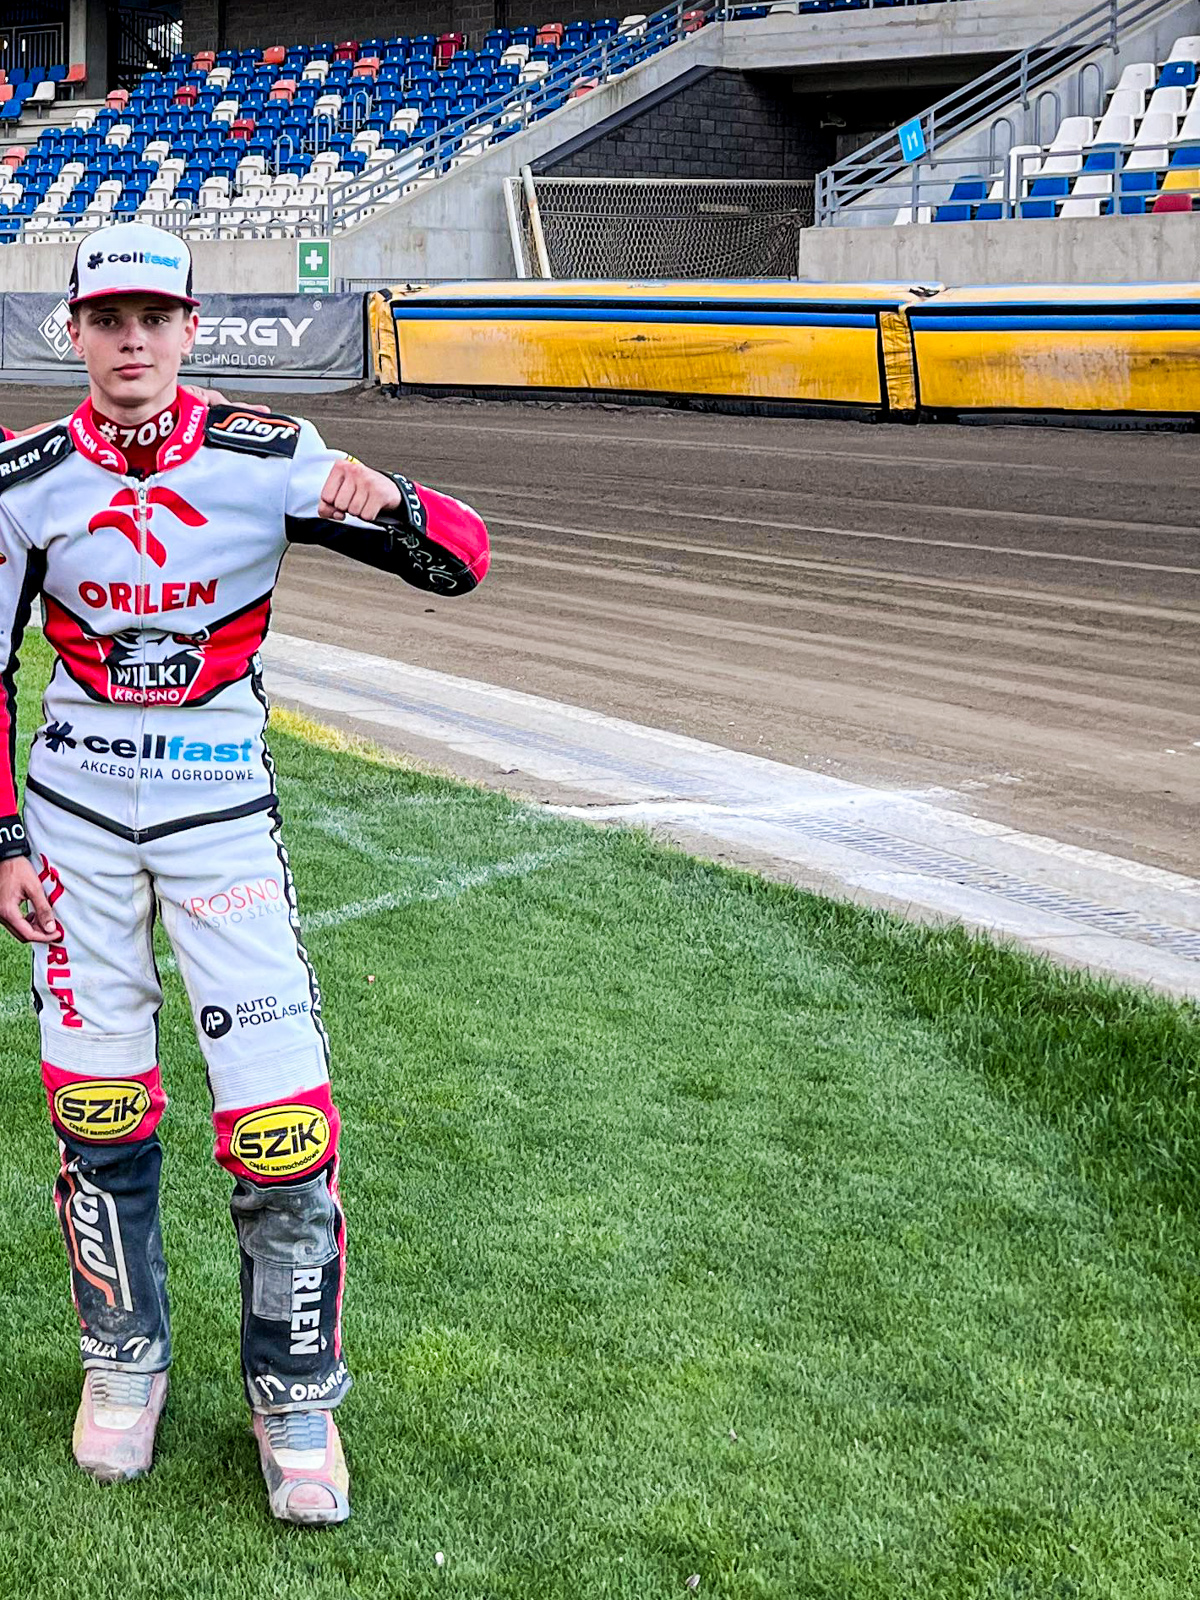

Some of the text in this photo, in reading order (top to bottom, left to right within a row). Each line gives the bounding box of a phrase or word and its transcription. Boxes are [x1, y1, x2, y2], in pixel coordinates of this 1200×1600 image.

[107, 251, 180, 269] cellfast
[189, 353, 276, 366] TECHNOLOGY
[72, 417, 98, 453] ORLEN
[99, 410, 175, 448] #708
[182, 405, 205, 443] ORLEN
[78, 579, 218, 615] ORLEN
[116, 664, 187, 687] WILKI
[114, 687, 180, 702] KROSNO
[83, 733, 253, 762] cellfast
[80, 759, 255, 781] AKCESORIA OGRODOWE
[236, 996, 277, 1015] AUTO
[239, 1000, 309, 1028] PODLASIE
[80, 1335, 118, 1358] ORLEN
